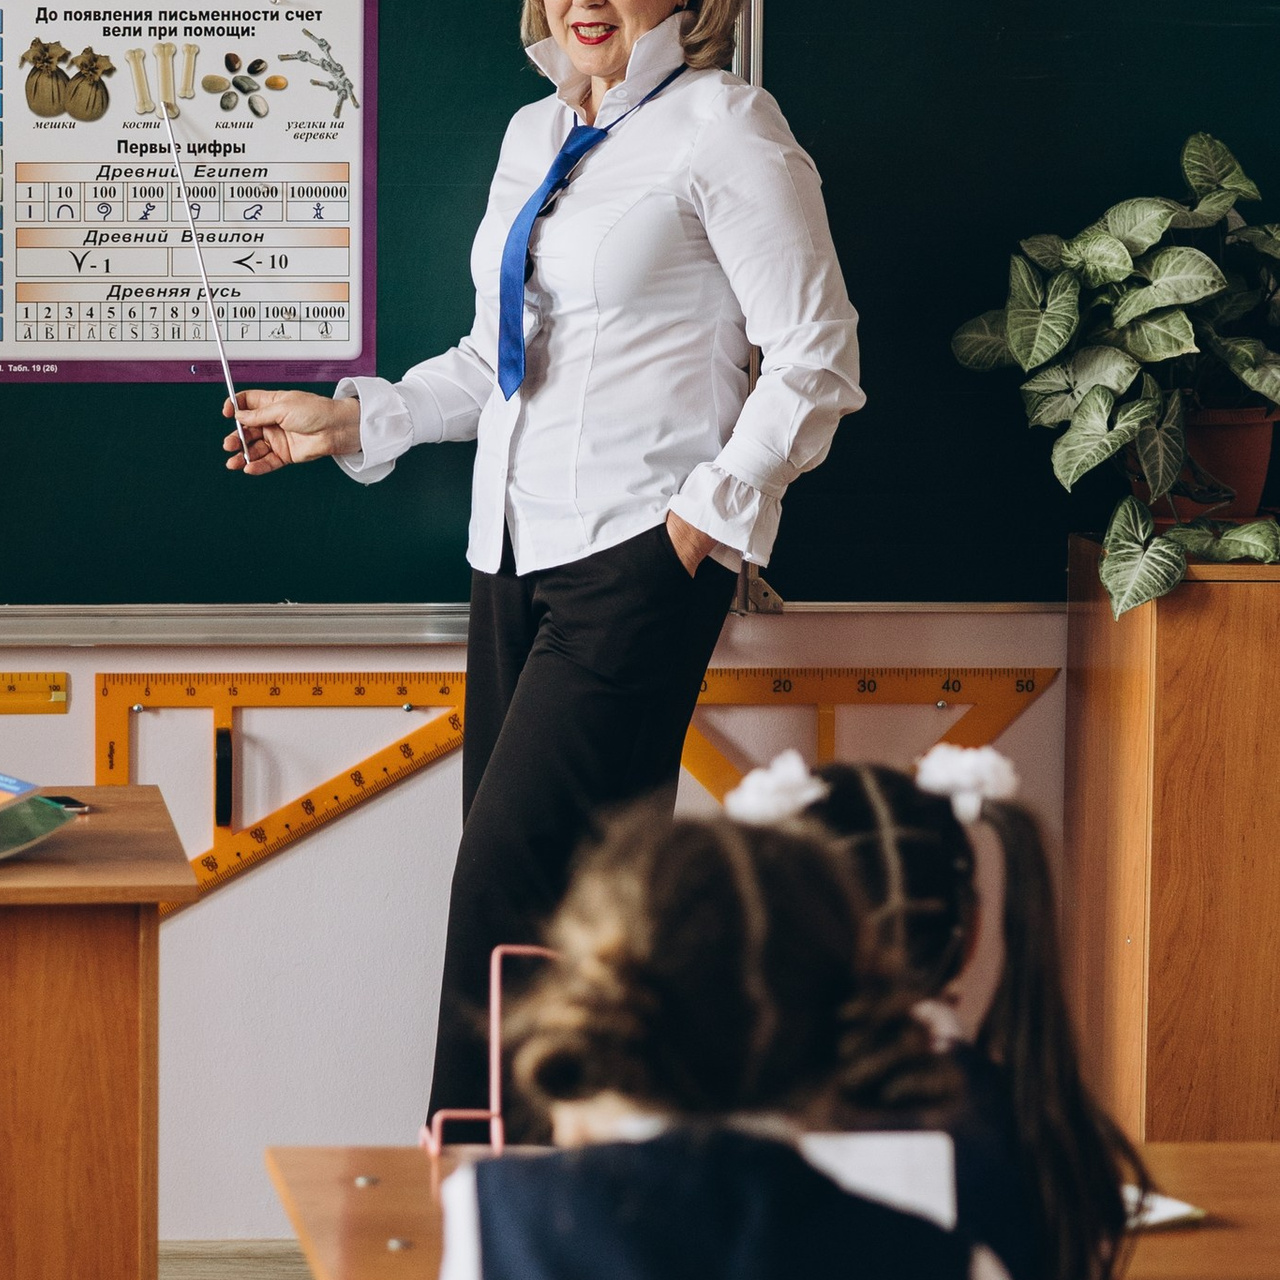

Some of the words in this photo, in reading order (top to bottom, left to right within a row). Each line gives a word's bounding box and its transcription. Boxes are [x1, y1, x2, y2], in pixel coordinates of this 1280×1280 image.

[35, 7, 58, 24] До
[63, 9, 153, 22] появления
[158, 9, 280, 22] письменности
[284, 9, 323, 22] счет
[102, 25, 143, 37] вели
[147, 26, 178, 41] при
[183, 24, 256, 40] помощи:
[32, 120, 77, 130] мешки
[122, 121, 161, 130] кости
[214, 120, 255, 130] камни
[285, 120, 325, 132] узелки
[329, 121, 345, 129] на
[293, 131, 339, 142] веревке
[117, 140, 182, 157] Первые
[186, 140, 246, 158] цифры
[194, 165, 269, 178] Египет
[82, 230, 169, 246] Древний
[181, 230, 265, 243] Вавилон
[106, 284, 191, 300] Древняя
[8, 364, 30, 372] Табл.
[31, 364, 41, 372] 19
[42, 364, 58, 373] (26)
[857, 679, 877, 693] 30
[941, 679, 962, 693] 40
